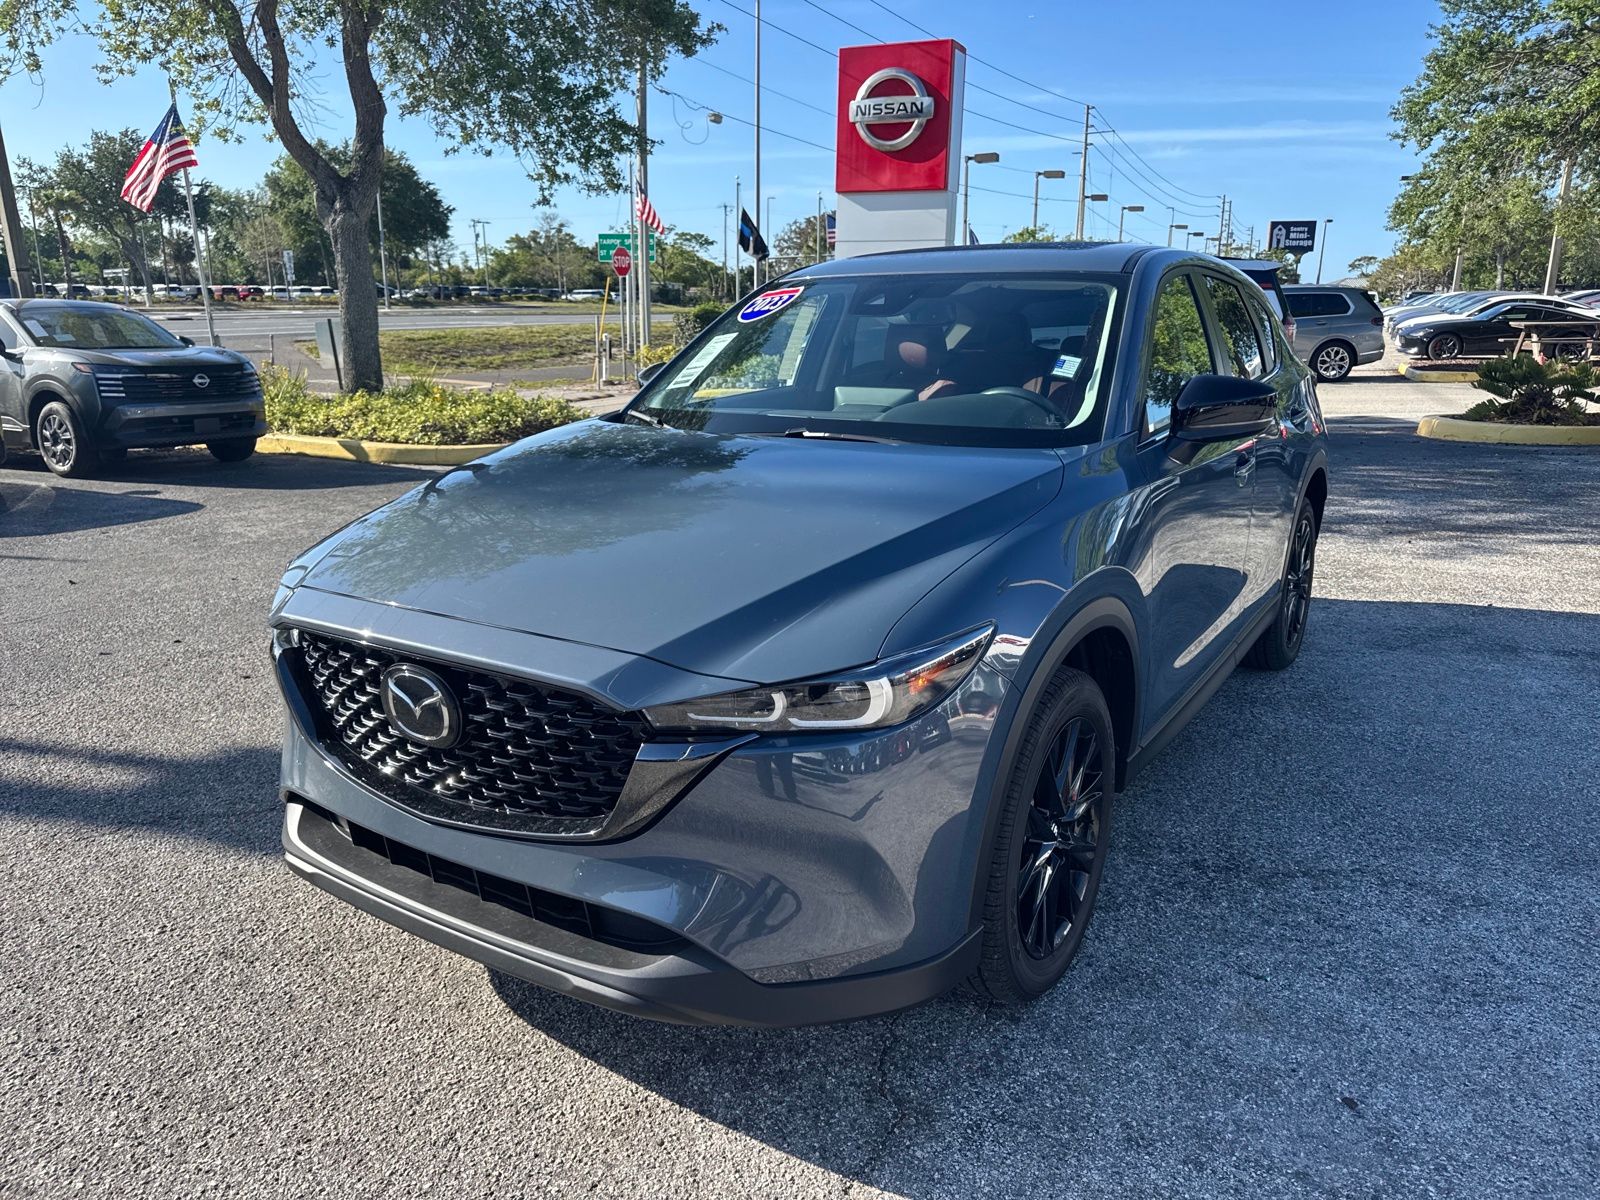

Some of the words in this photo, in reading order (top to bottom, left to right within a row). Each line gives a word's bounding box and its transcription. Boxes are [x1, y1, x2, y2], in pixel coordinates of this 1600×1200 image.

[855, 101, 924, 117] NISSAN
[1285, 239, 1313, 247] Storage
[613, 255, 630, 268] STOP
[743, 294, 790, 313] 2023
